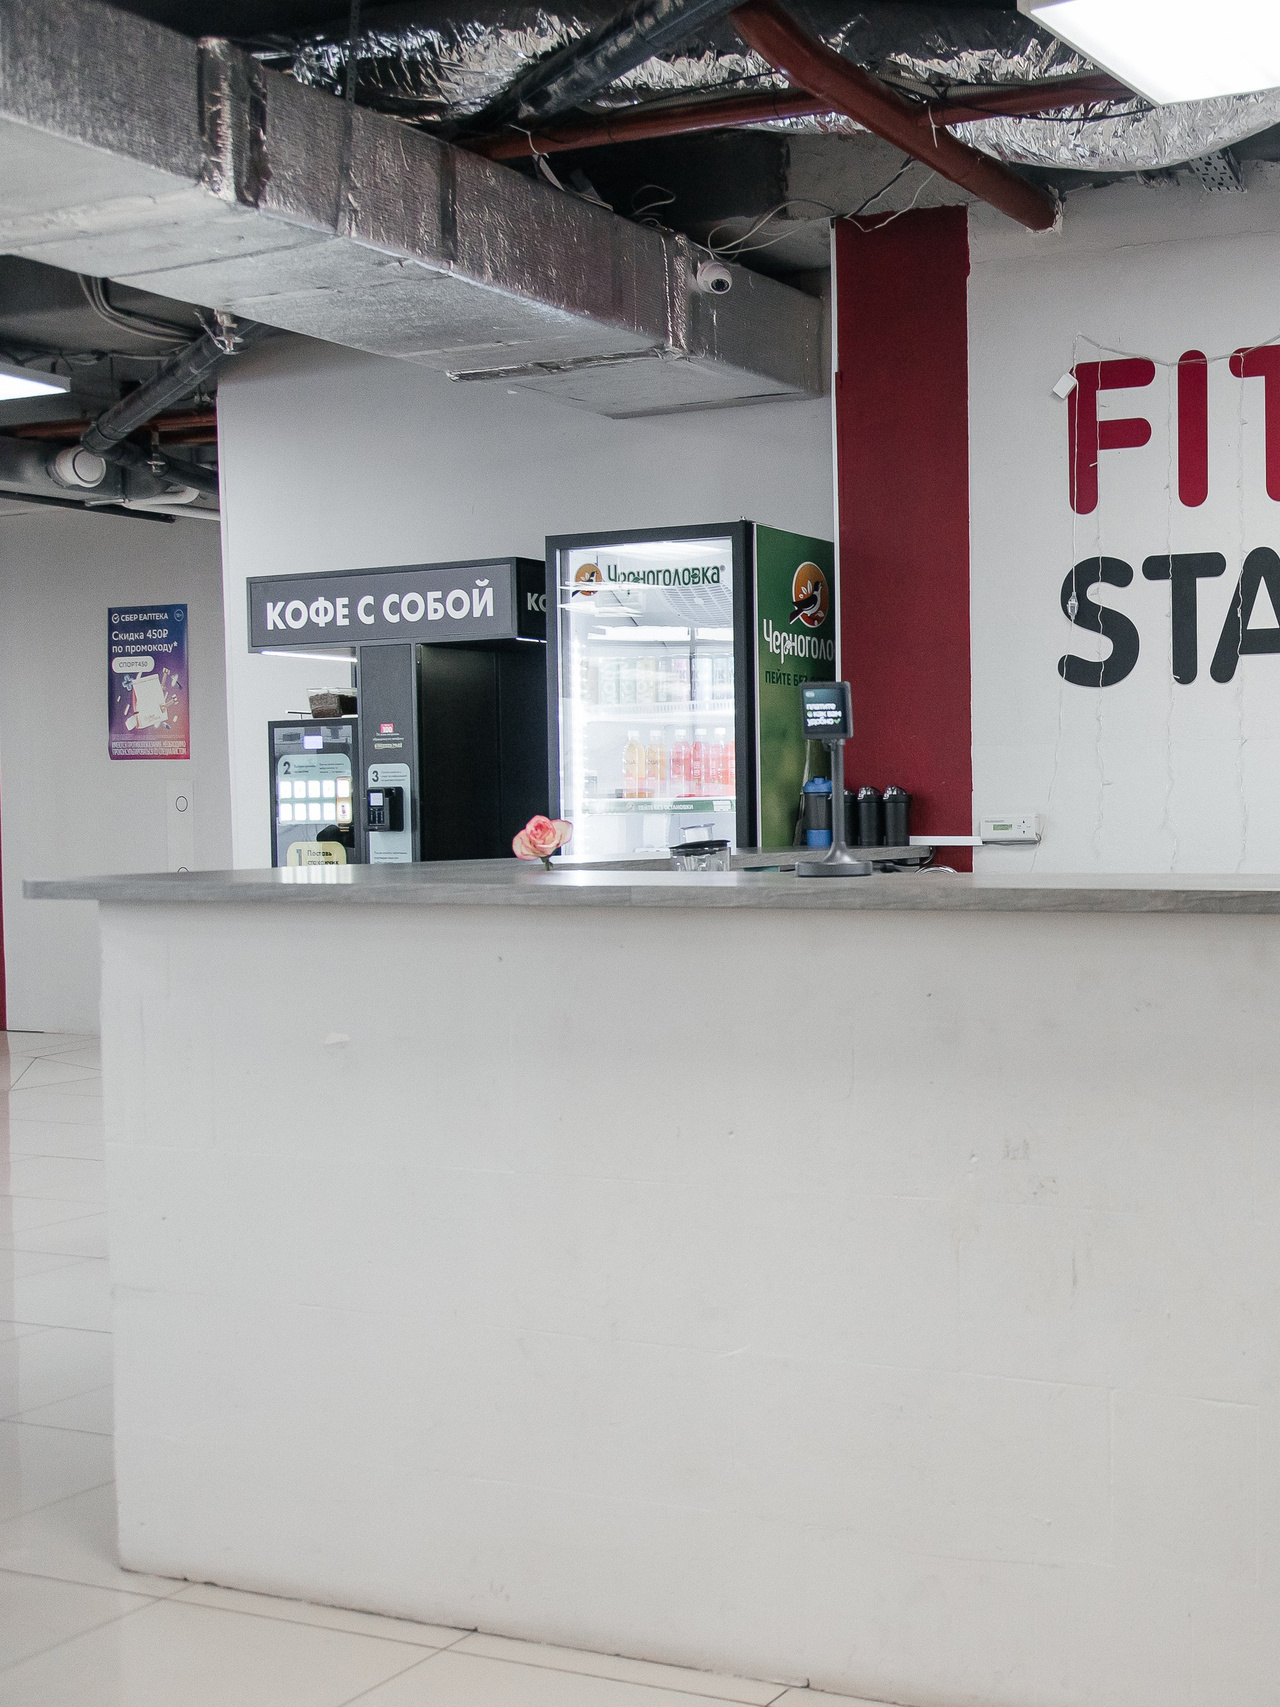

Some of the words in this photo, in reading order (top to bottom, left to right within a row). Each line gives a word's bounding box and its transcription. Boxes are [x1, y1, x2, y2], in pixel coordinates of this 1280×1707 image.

[266, 596, 350, 630] КОФЕ
[357, 595, 375, 625] С
[382, 578, 494, 623] СОБОЙ
[121, 614, 138, 622] СБЕР
[112, 631, 144, 641] Скидка
[146, 629, 169, 639] 450₽
[112, 645, 123, 653] по
[765, 668, 792, 686] ПЕЙТЕ
[283, 761, 291, 775] 2
[372, 770, 379, 782] 3
[296, 849, 302, 866] 1
